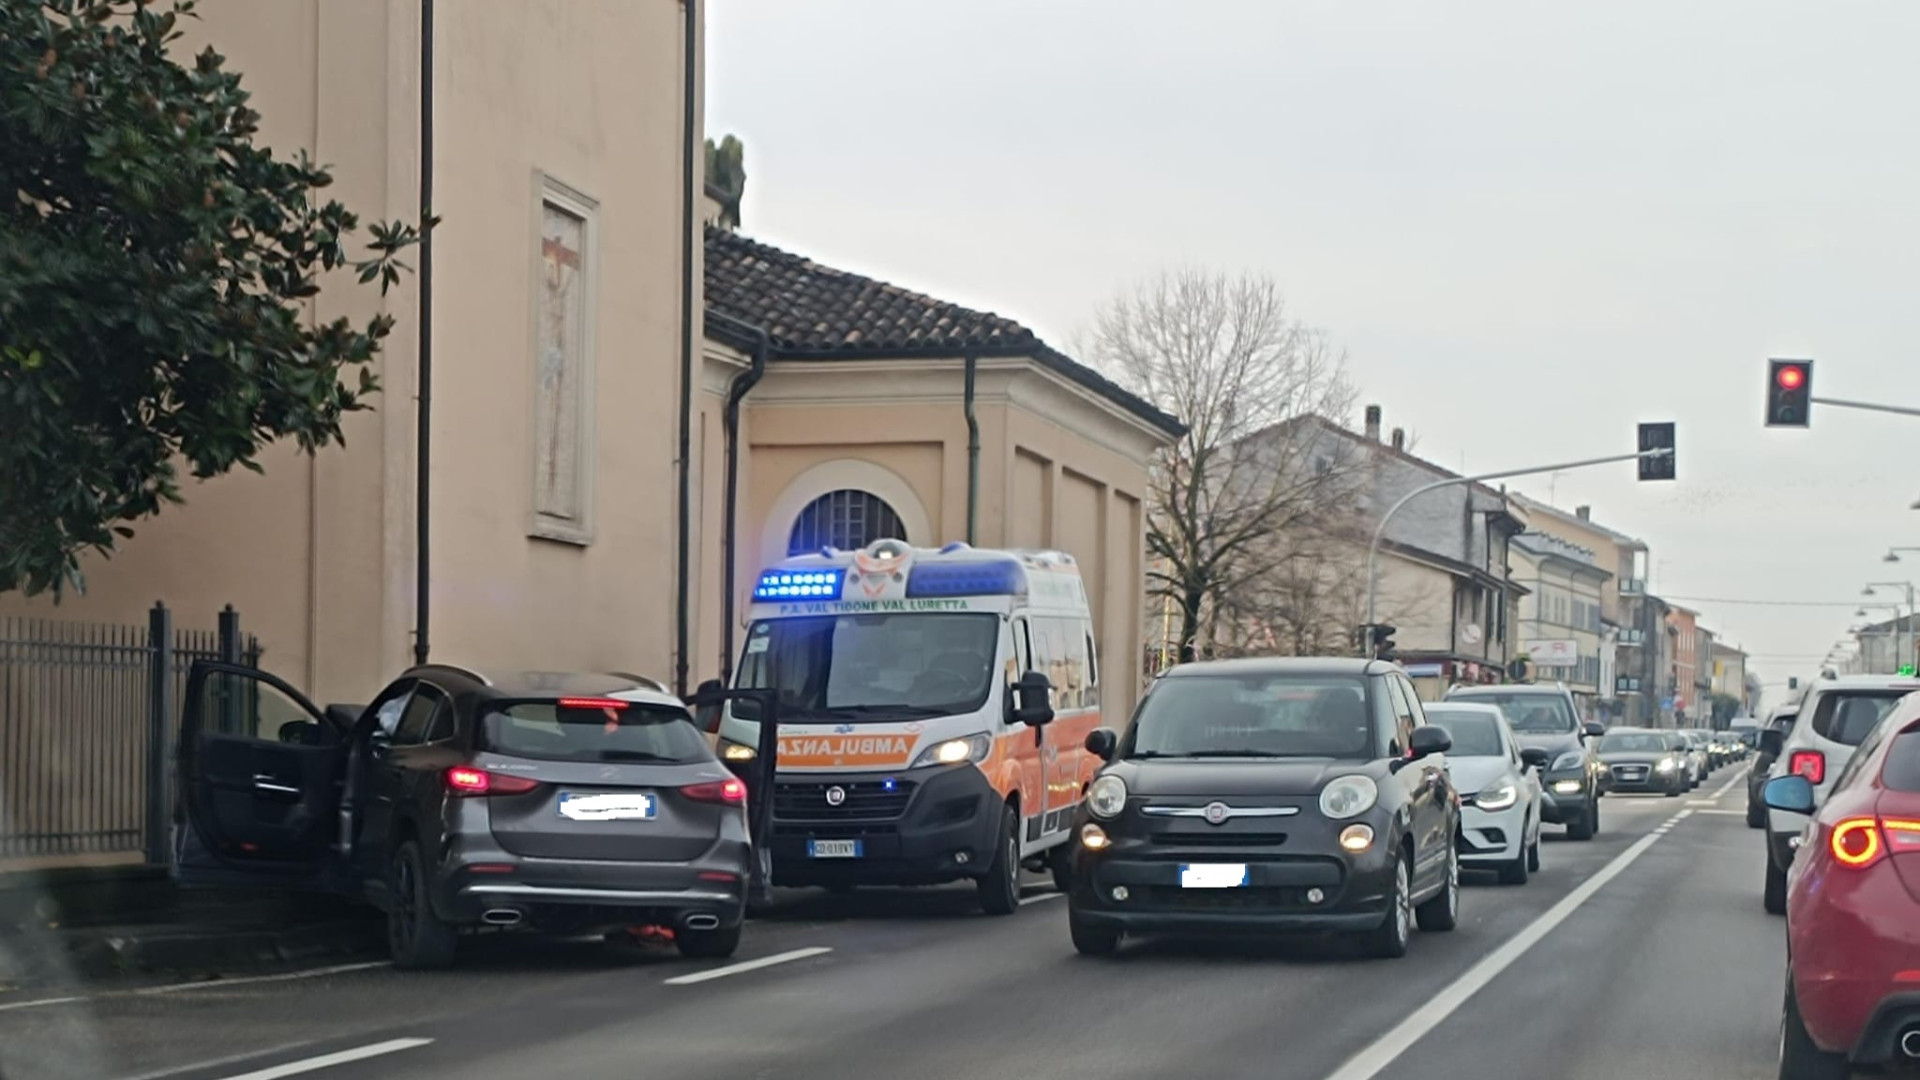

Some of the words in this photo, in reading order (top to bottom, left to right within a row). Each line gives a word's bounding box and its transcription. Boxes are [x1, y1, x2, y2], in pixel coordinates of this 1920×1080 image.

[780, 604, 800, 615] P.A.
[806, 602, 829, 614] VAL
[833, 601, 878, 612] TIDONE
[882, 601, 905, 611] VAL
[909, 599, 968, 610] LURETTA
